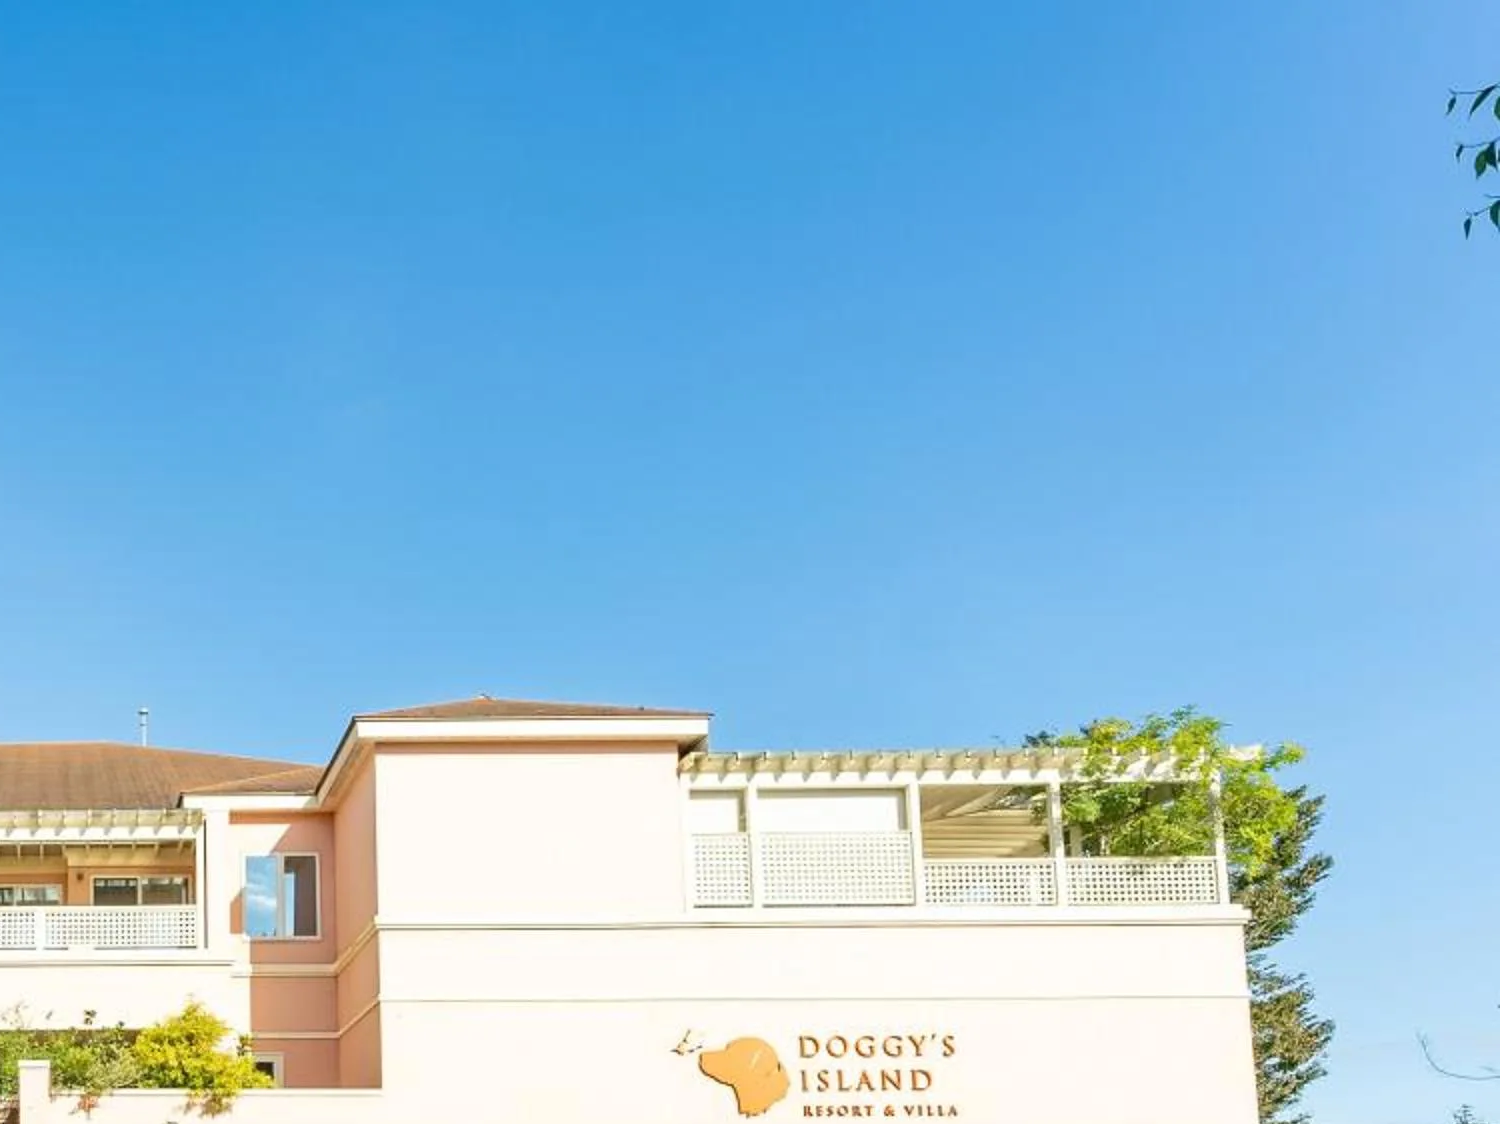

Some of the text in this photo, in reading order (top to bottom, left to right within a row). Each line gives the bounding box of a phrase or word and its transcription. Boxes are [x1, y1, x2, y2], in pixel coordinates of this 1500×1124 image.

[798, 1034, 956, 1059] DOGGY'S
[800, 1069, 933, 1092] ISLAND
[803, 1104, 959, 1117] RESORT & VILLA
